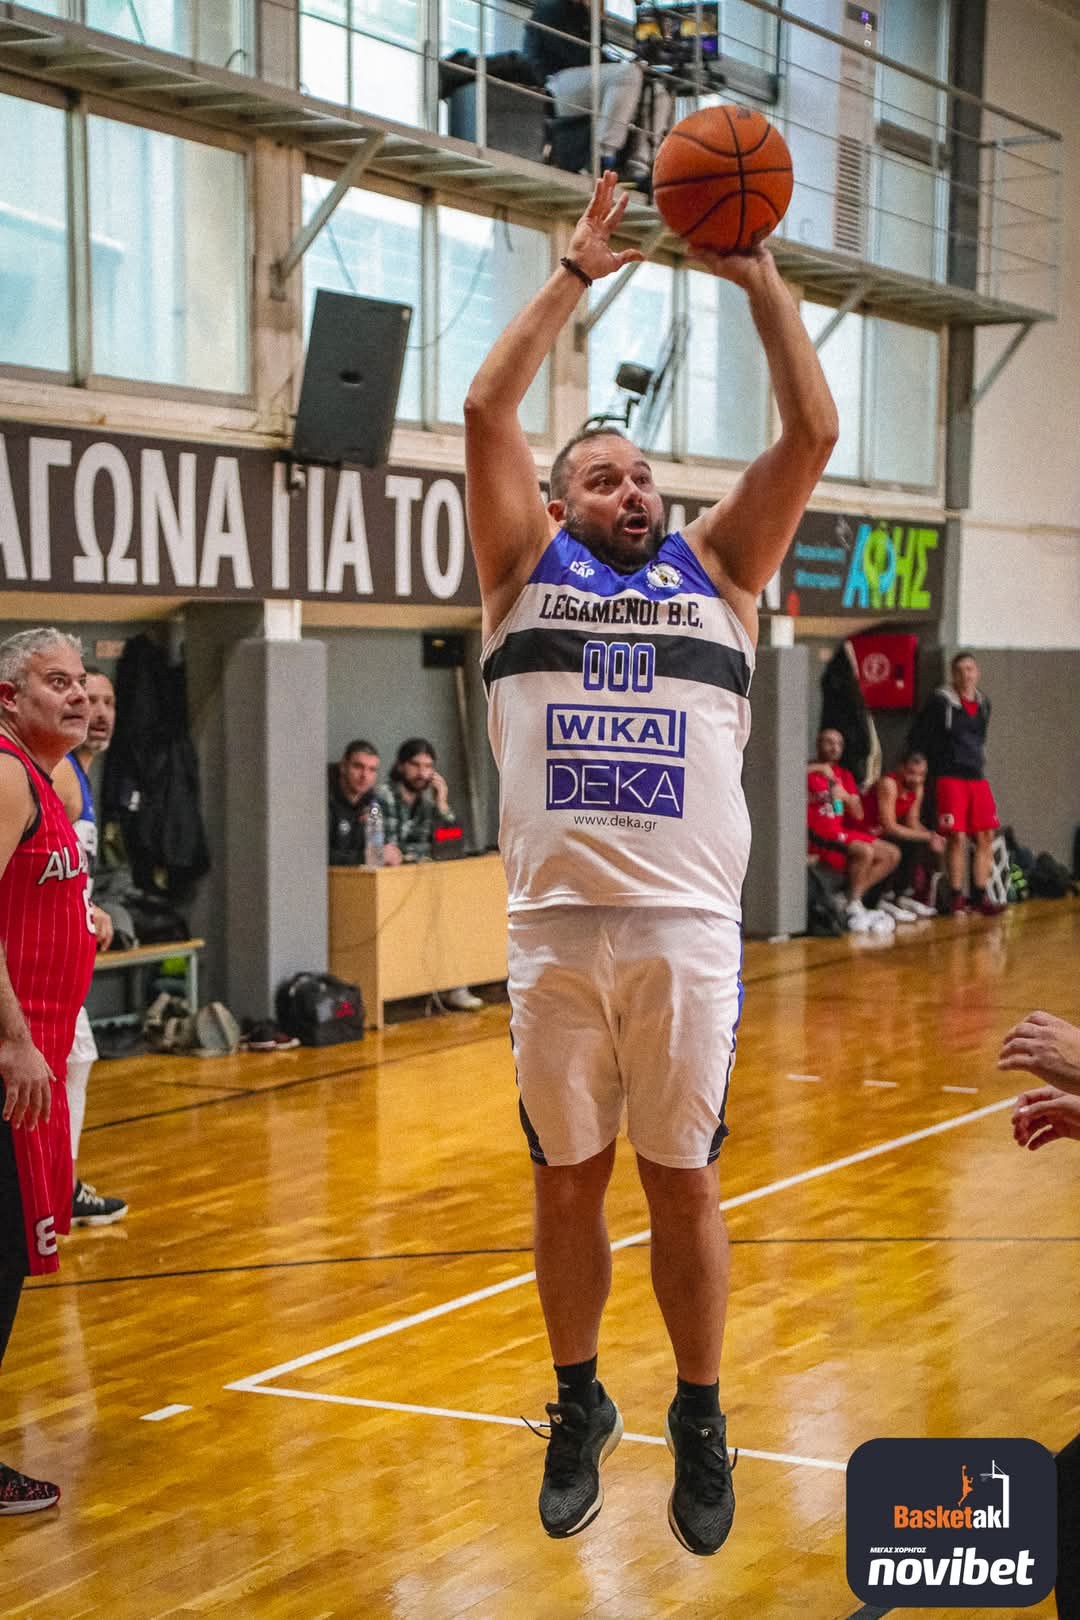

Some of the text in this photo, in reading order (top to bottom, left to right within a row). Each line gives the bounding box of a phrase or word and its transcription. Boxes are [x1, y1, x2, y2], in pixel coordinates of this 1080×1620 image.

[385, 474, 465, 599] ΤΟ
[539, 593, 703, 629] LEGAMENOI B.C.
[549, 764, 681, 812] DEKA
[573, 814, 657, 832] www.deka.gr
